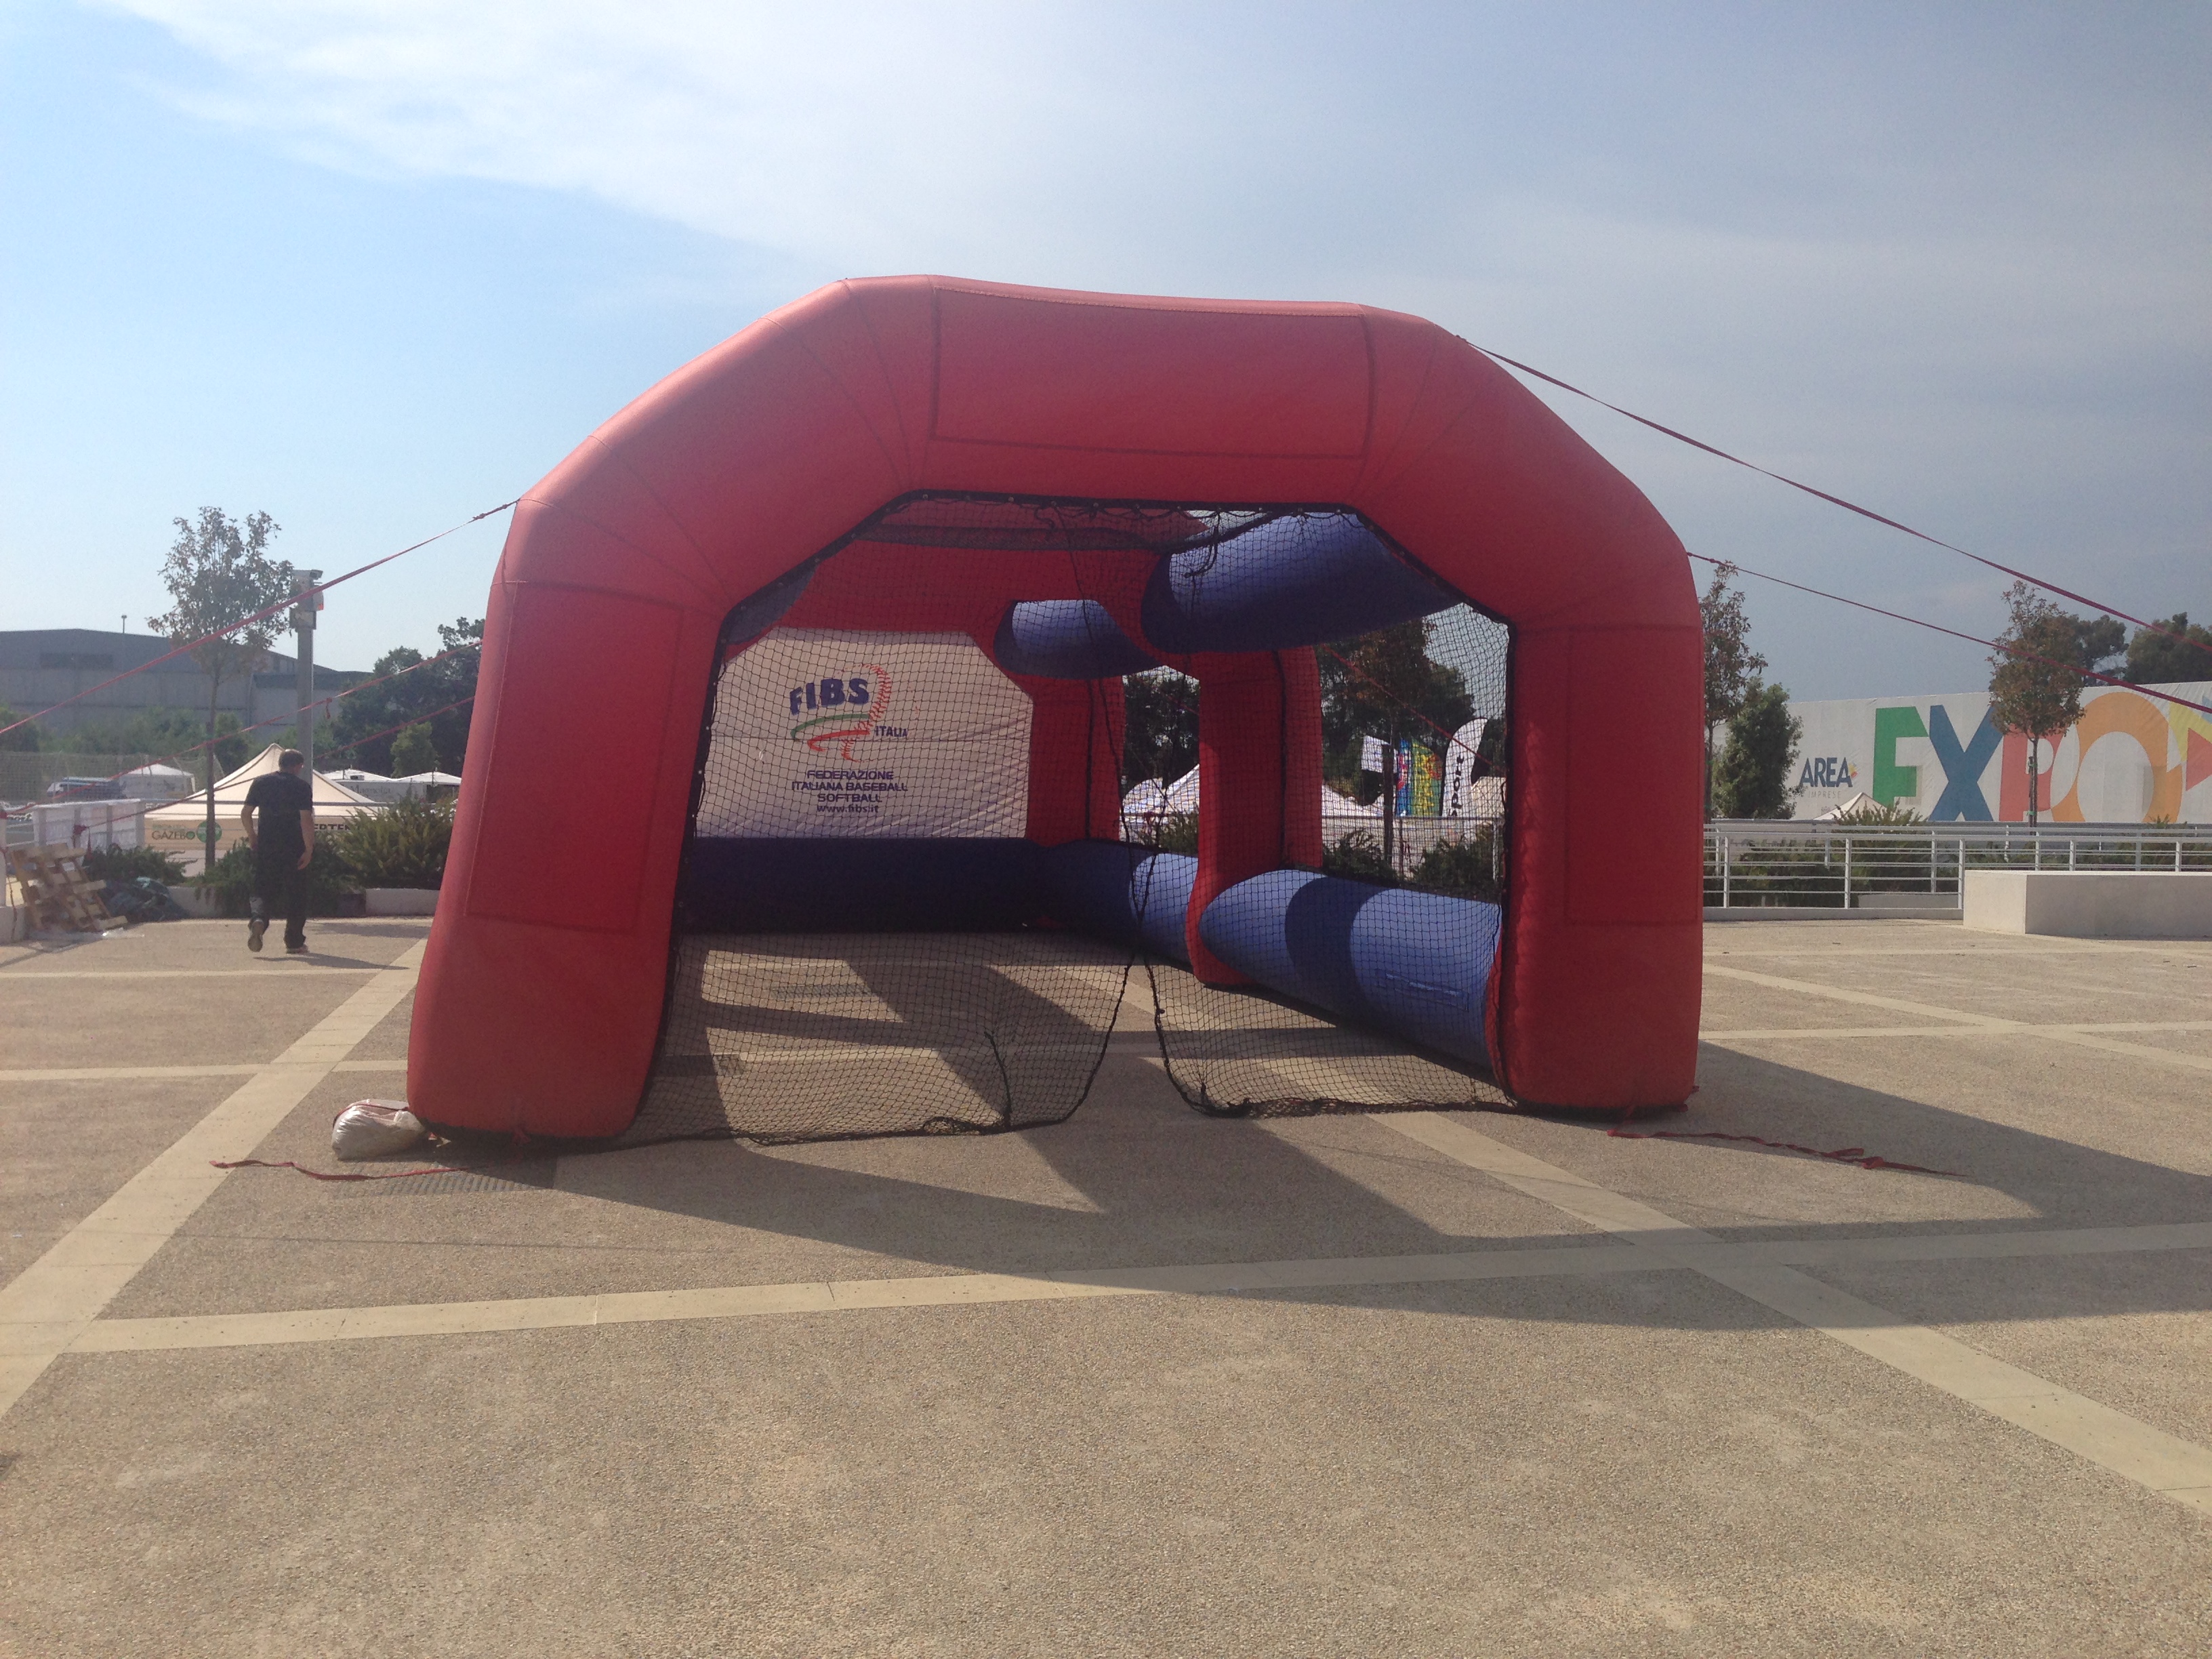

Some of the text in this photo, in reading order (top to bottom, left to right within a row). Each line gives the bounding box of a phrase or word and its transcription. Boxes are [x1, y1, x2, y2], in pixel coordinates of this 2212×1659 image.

[790, 678, 869, 716] FIBS
[875, 725, 908, 737] ITALIA
[1872, 691, 2183, 822] EXPO
[806, 770, 895, 780] FEDERAZIONE
[1799, 756, 1853, 787] AREA
[792, 781, 909, 792] ITALIANA BASEBALL
[817, 794, 882, 802] SOFTBALL
[817, 804, 879, 813] www.fibs.it
[152, 830, 195, 840] GAZEBO
